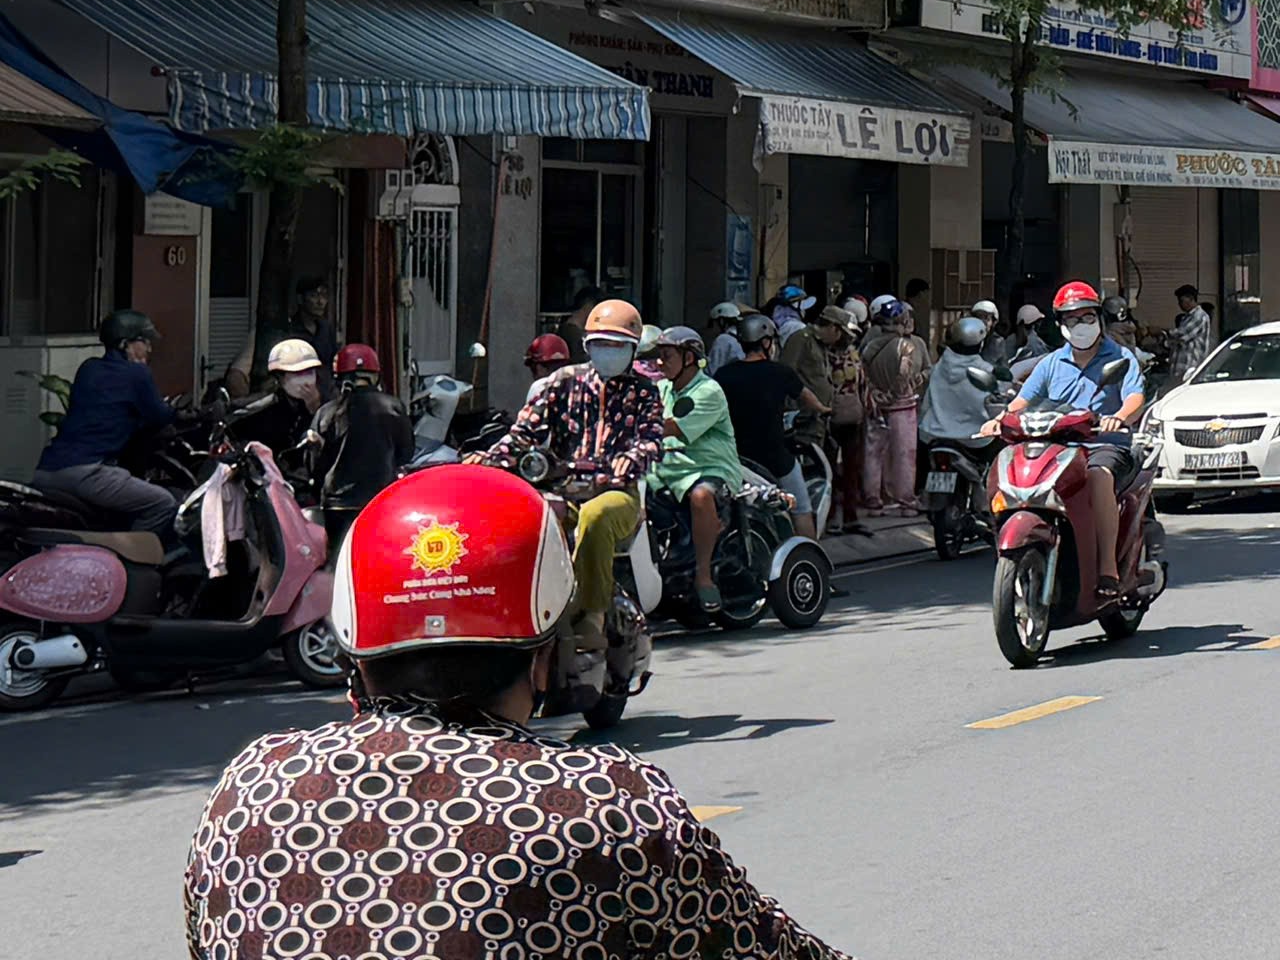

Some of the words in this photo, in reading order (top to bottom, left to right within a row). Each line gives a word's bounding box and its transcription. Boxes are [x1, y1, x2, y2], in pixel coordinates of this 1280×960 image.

[653, 70, 714, 98] THANH
[769, 100, 808, 124] THUỐC
[810, 103, 832, 127] TÂY
[836, 107, 880, 151] LÊ
[895, 119, 950, 162] LỢI
[1176, 152, 1248, 176] PHƯỚC
[167, 246, 186, 266] 60
